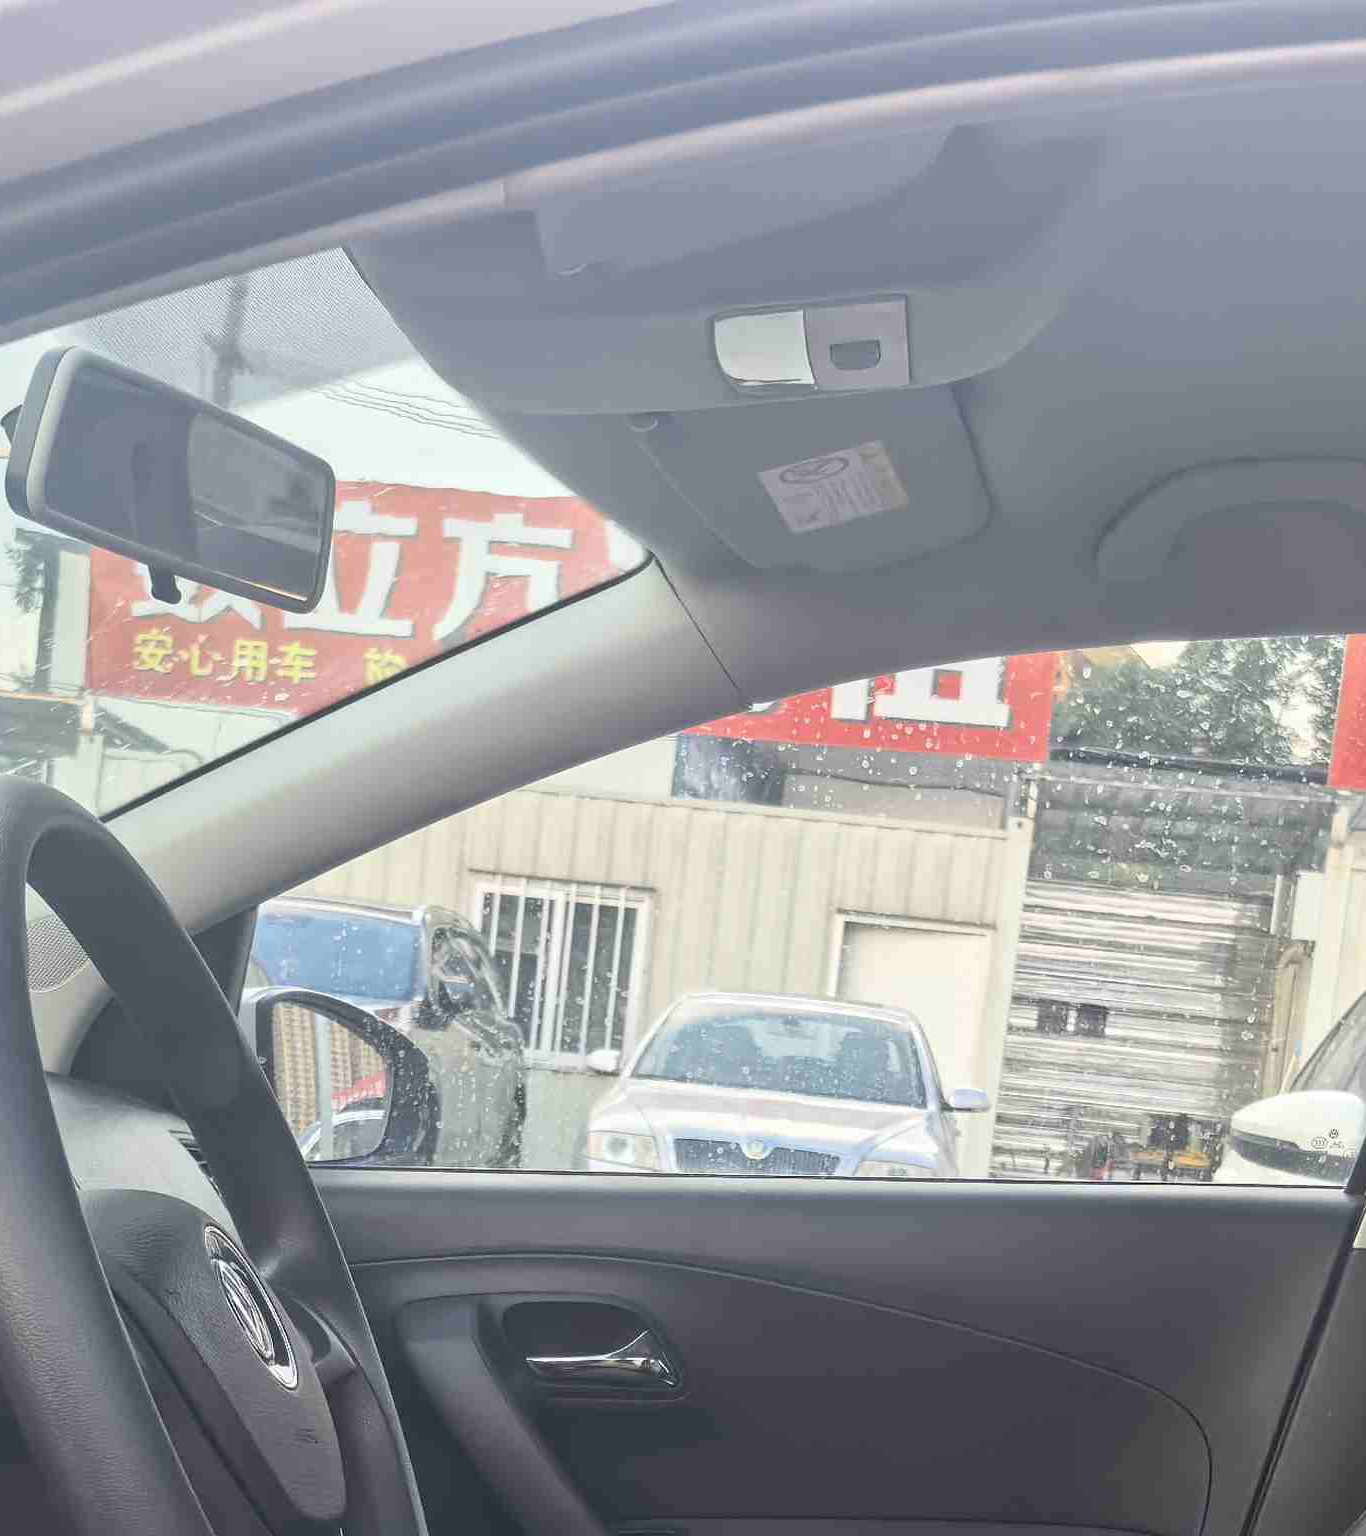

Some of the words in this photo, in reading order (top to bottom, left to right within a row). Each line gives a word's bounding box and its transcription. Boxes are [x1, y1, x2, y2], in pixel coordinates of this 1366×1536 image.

[132, 500, 643, 640] 立方
[134, 628, 316, 684] 安心用车
